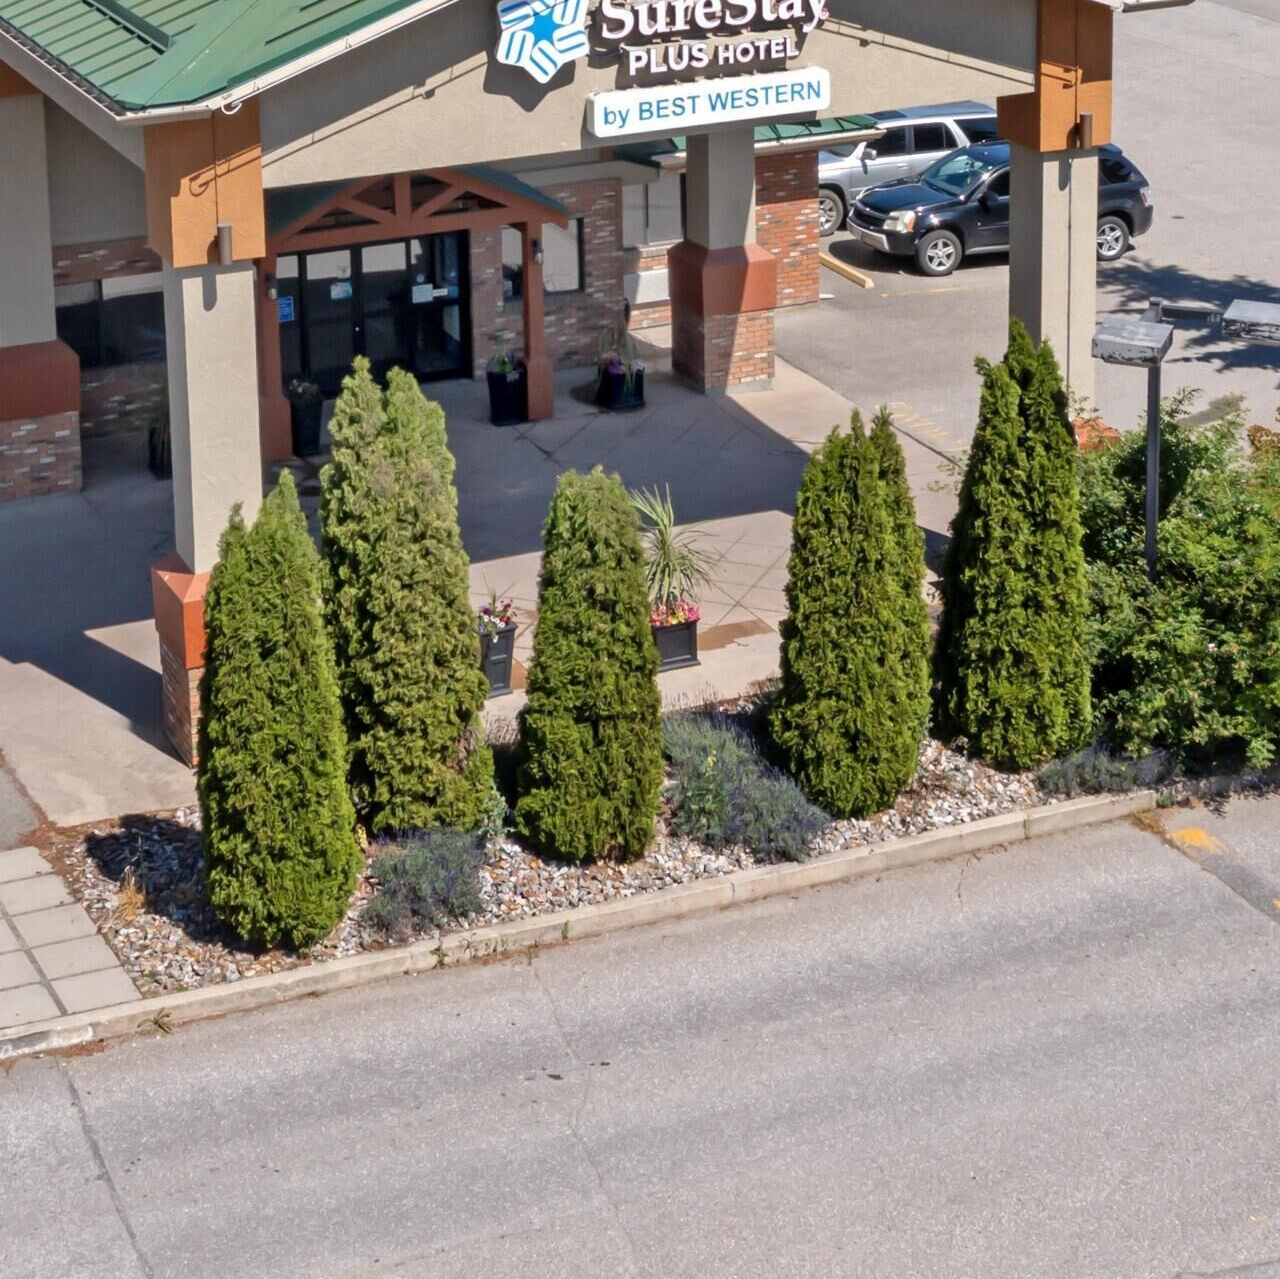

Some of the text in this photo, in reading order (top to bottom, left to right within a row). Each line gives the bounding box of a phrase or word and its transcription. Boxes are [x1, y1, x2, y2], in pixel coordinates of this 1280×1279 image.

[628, 37, 799, 76] PLUS HOTEL
[603, 80, 821, 128] by BEST WESTERN
